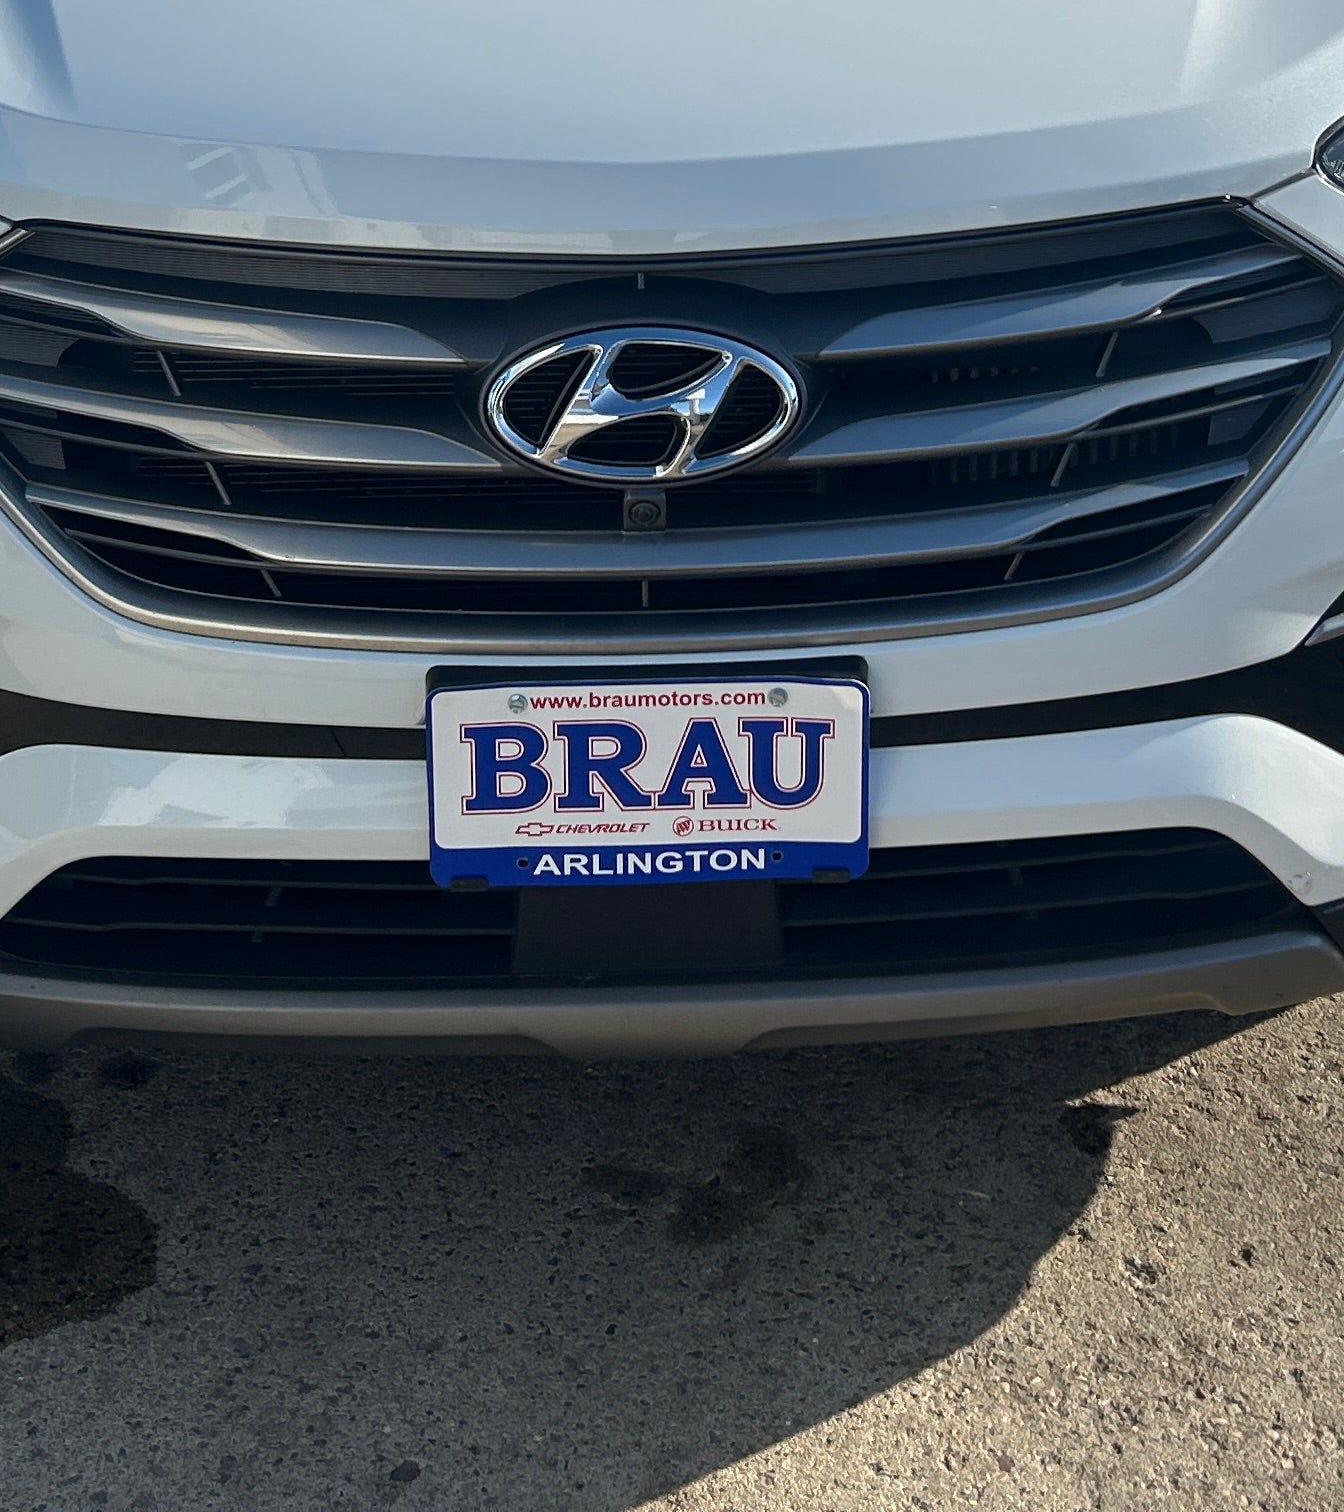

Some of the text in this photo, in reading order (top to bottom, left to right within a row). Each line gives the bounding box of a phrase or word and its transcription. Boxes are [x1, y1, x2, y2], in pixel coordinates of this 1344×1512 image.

[530, 691, 766, 709] www.braumotors.com
[460, 717, 836, 816] BRAU
[556, 818, 778, 834] CHEVROLET BUICK
[534, 848, 765, 876] ARLINGTON
